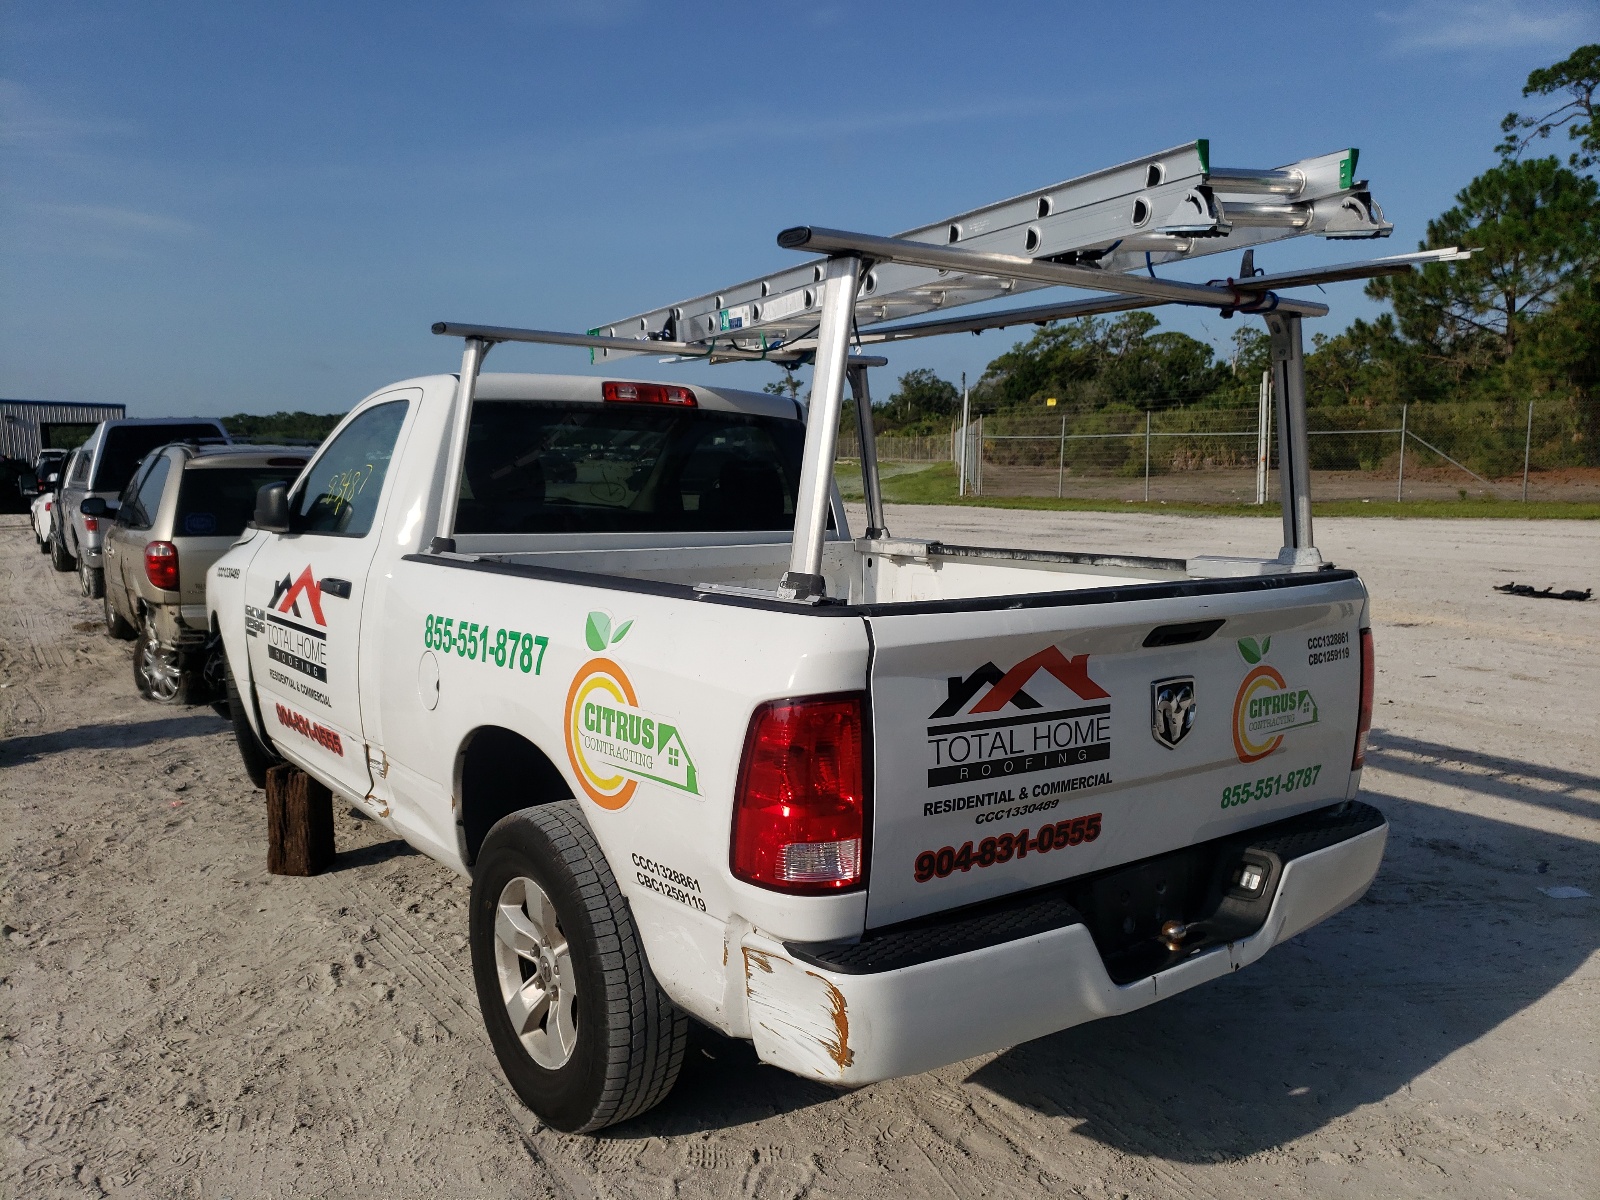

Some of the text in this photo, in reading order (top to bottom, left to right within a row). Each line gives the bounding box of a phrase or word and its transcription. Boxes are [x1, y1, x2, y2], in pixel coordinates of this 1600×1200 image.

[267, 623, 327, 666] TOTAL HOME
[424, 613, 550, 676] 855-551-8787
[1307, 632, 1350, 651] CCC1328861
[1308, 647, 1350, 667] CBC1259119
[275, 650, 318, 677] ROOFING
[1248, 691, 1298, 719] CITRUS
[1248, 710, 1296, 732] CONTRACTING
[275, 702, 344, 757] 904-831-0555
[584, 702, 656, 751] CITRUS
[928, 717, 1111, 765] TOTAL HOME
[583, 735, 654, 770] CONTRACTING
[959, 749, 1089, 782] ROOFING
[923, 772, 1113, 817] RESIDENTIAL & COMMERCIAL
[1220, 764, 1322, 810] 855-551-8787
[974, 799, 1060, 825] CCC1330489
[913, 811, 1103, 884] 904-831-0555
[631, 852, 702, 894] CCC1328861
[636, 871, 707, 912] CBC1259119
